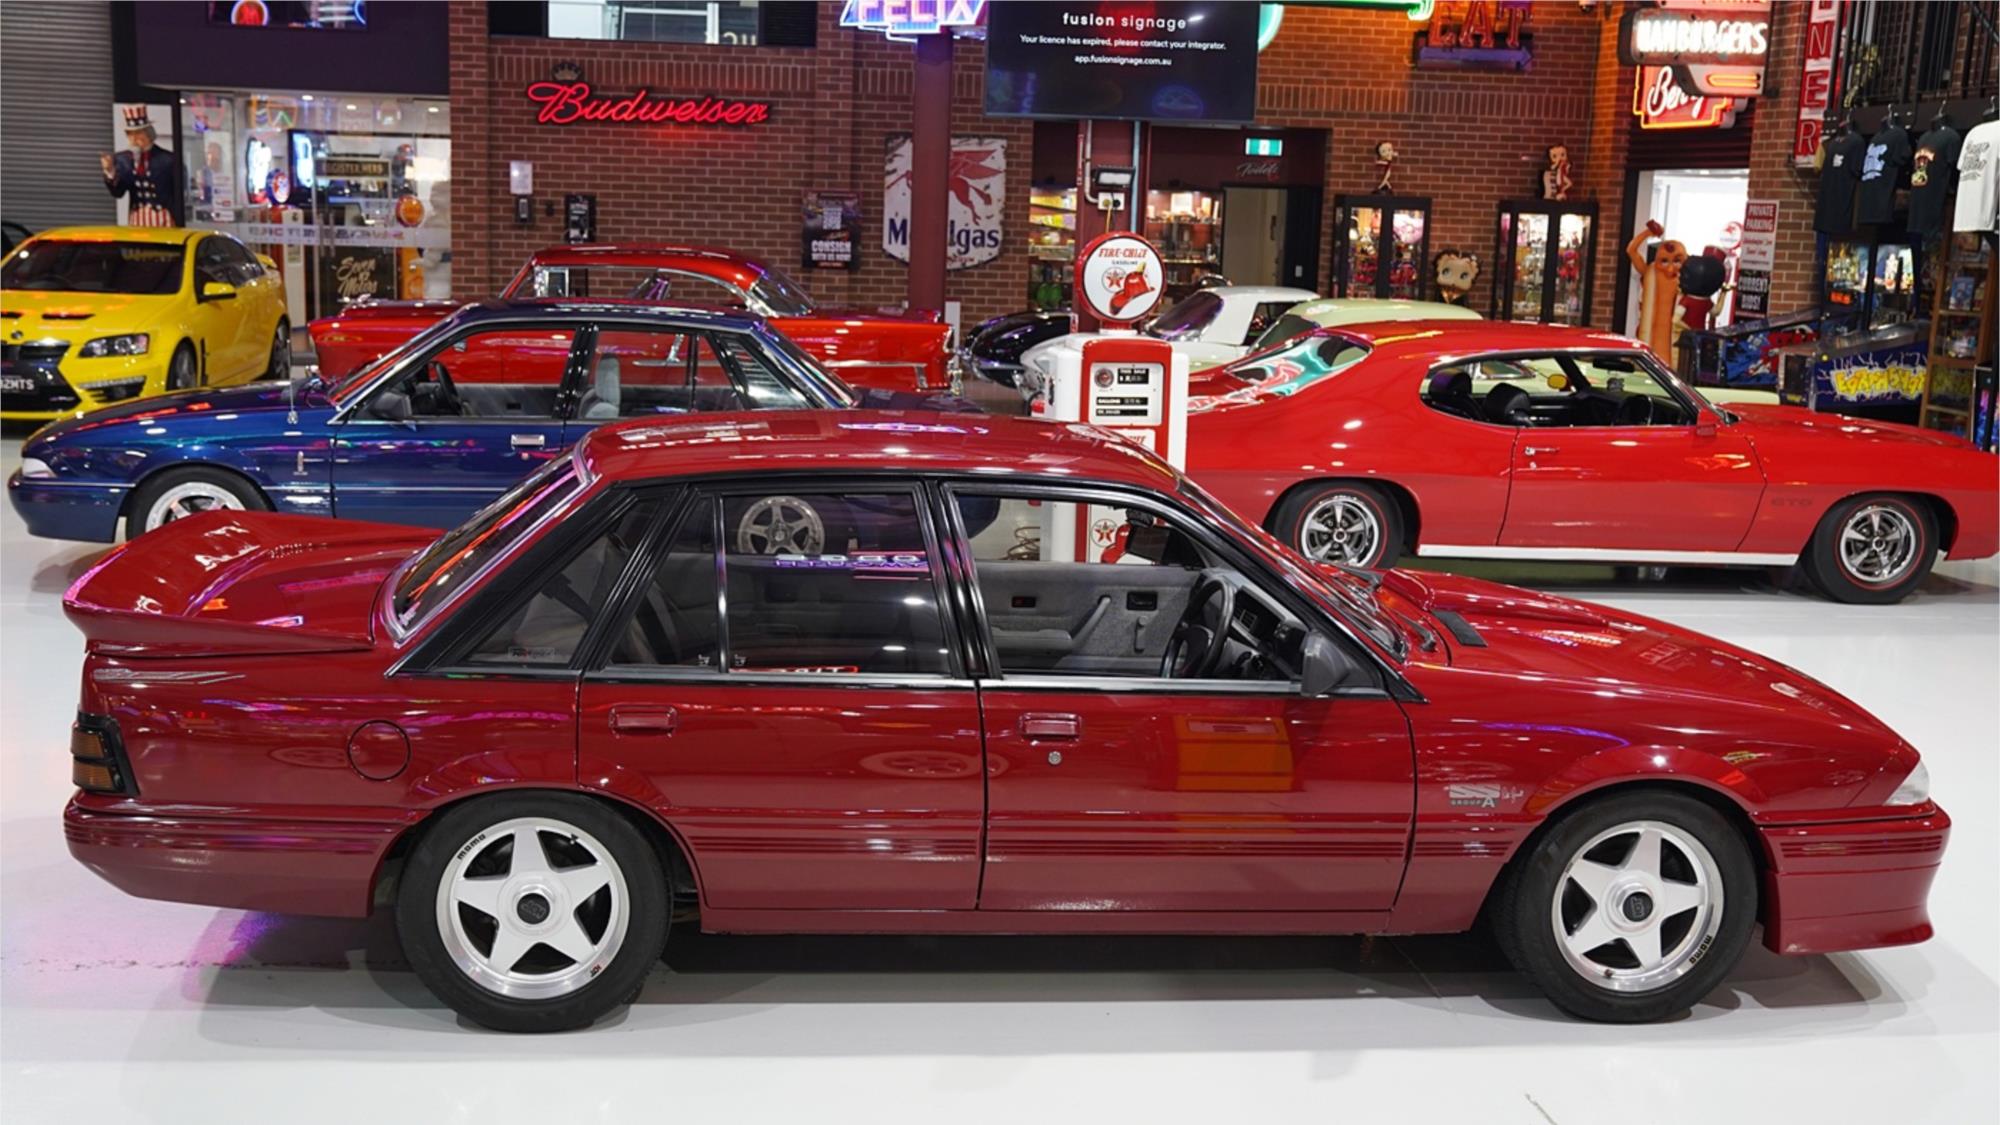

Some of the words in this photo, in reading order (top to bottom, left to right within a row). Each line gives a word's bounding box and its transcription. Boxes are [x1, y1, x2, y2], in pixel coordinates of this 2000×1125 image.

[1062, 12, 1115, 26] fusion
[1121, 15, 1187, 32] signage
[1428, 0, 1533, 48] EAT
[1636, 19, 1768, 55] HAMBURGERS
[1020, 34, 1037, 44] Your
[1039, 35, 1066, 45] licence
[1067, 36, 1081, 46] has
[1082, 37, 1112, 47] expired,
[1114, 38, 1139, 48] please
[1140, 39, 1168, 49] contact
[1170, 41, 1186, 50] your
[1188, 40, 1226, 50] integrator.
[1074, 55, 1172, 66] app.fusionsignage.com.au
[1795, 0, 1839, 156] NER
[527, 82, 769, 124] Budweiser
[811, 240, 852, 252] CONSIGN
[888, 218, 1000, 255] Mlgas
[457, 833, 487, 860] momo
